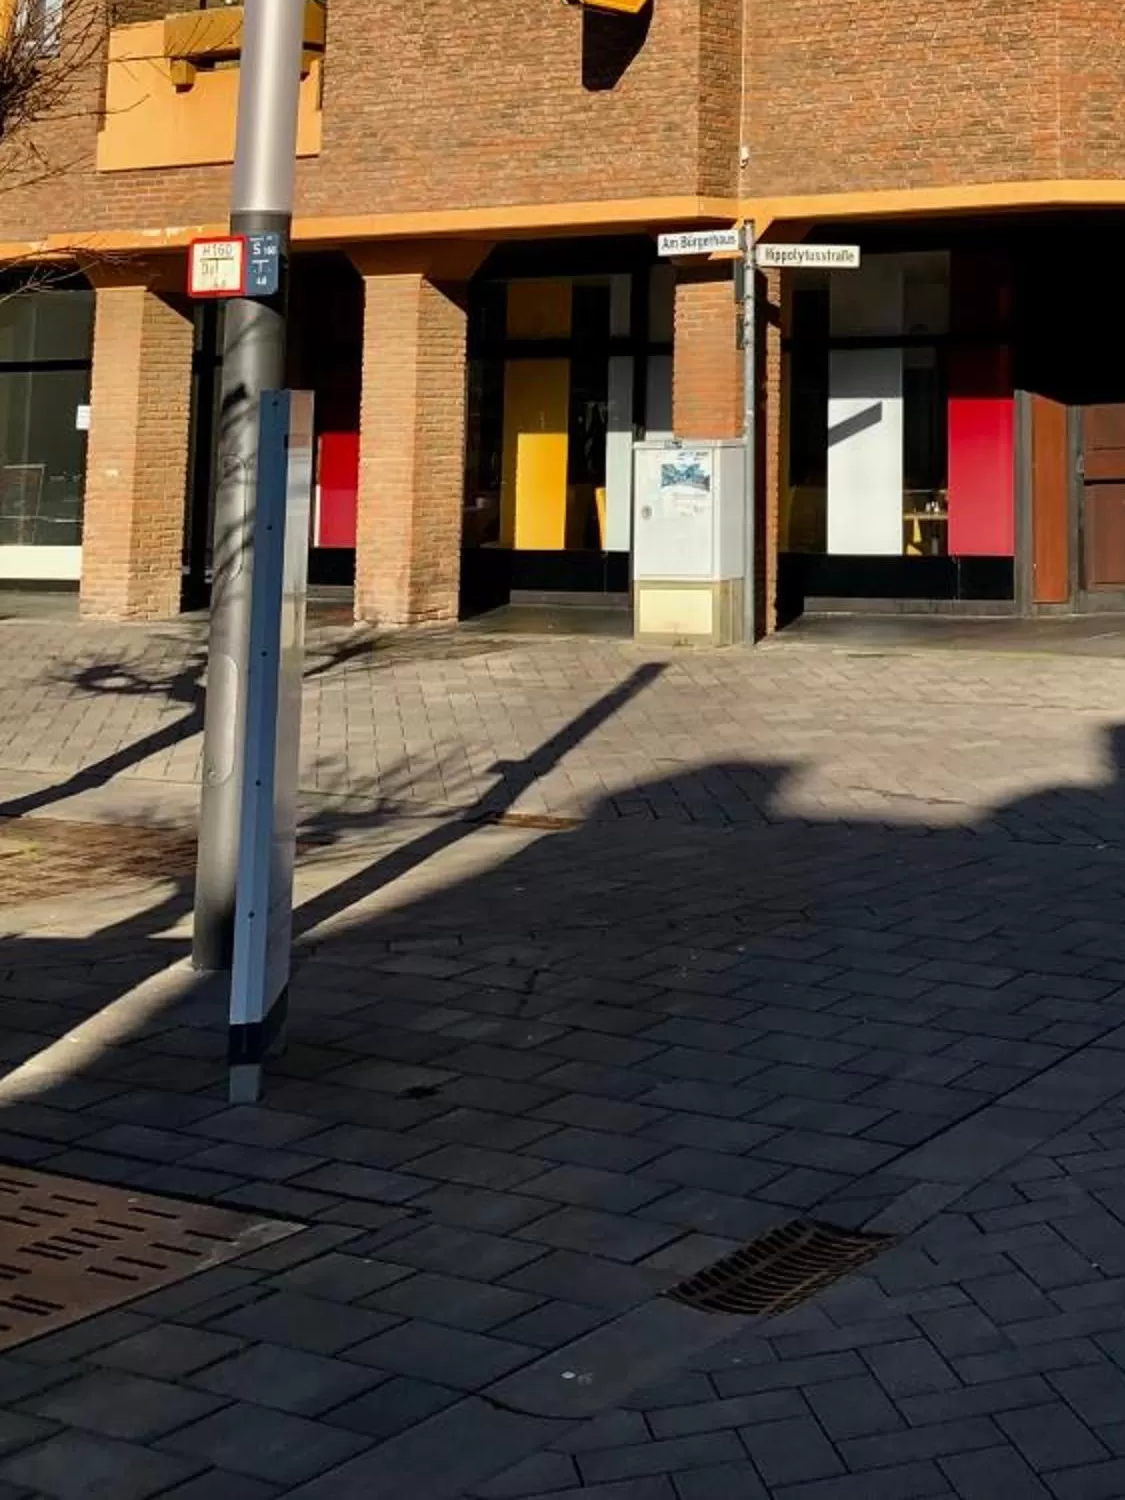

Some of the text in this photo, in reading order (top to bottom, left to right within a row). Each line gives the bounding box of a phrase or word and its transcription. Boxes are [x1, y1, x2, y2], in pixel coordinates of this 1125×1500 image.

[661, 233, 736, 251] Am Bürgerhaus
[764, 247, 855, 265] Hippolytusstraße
